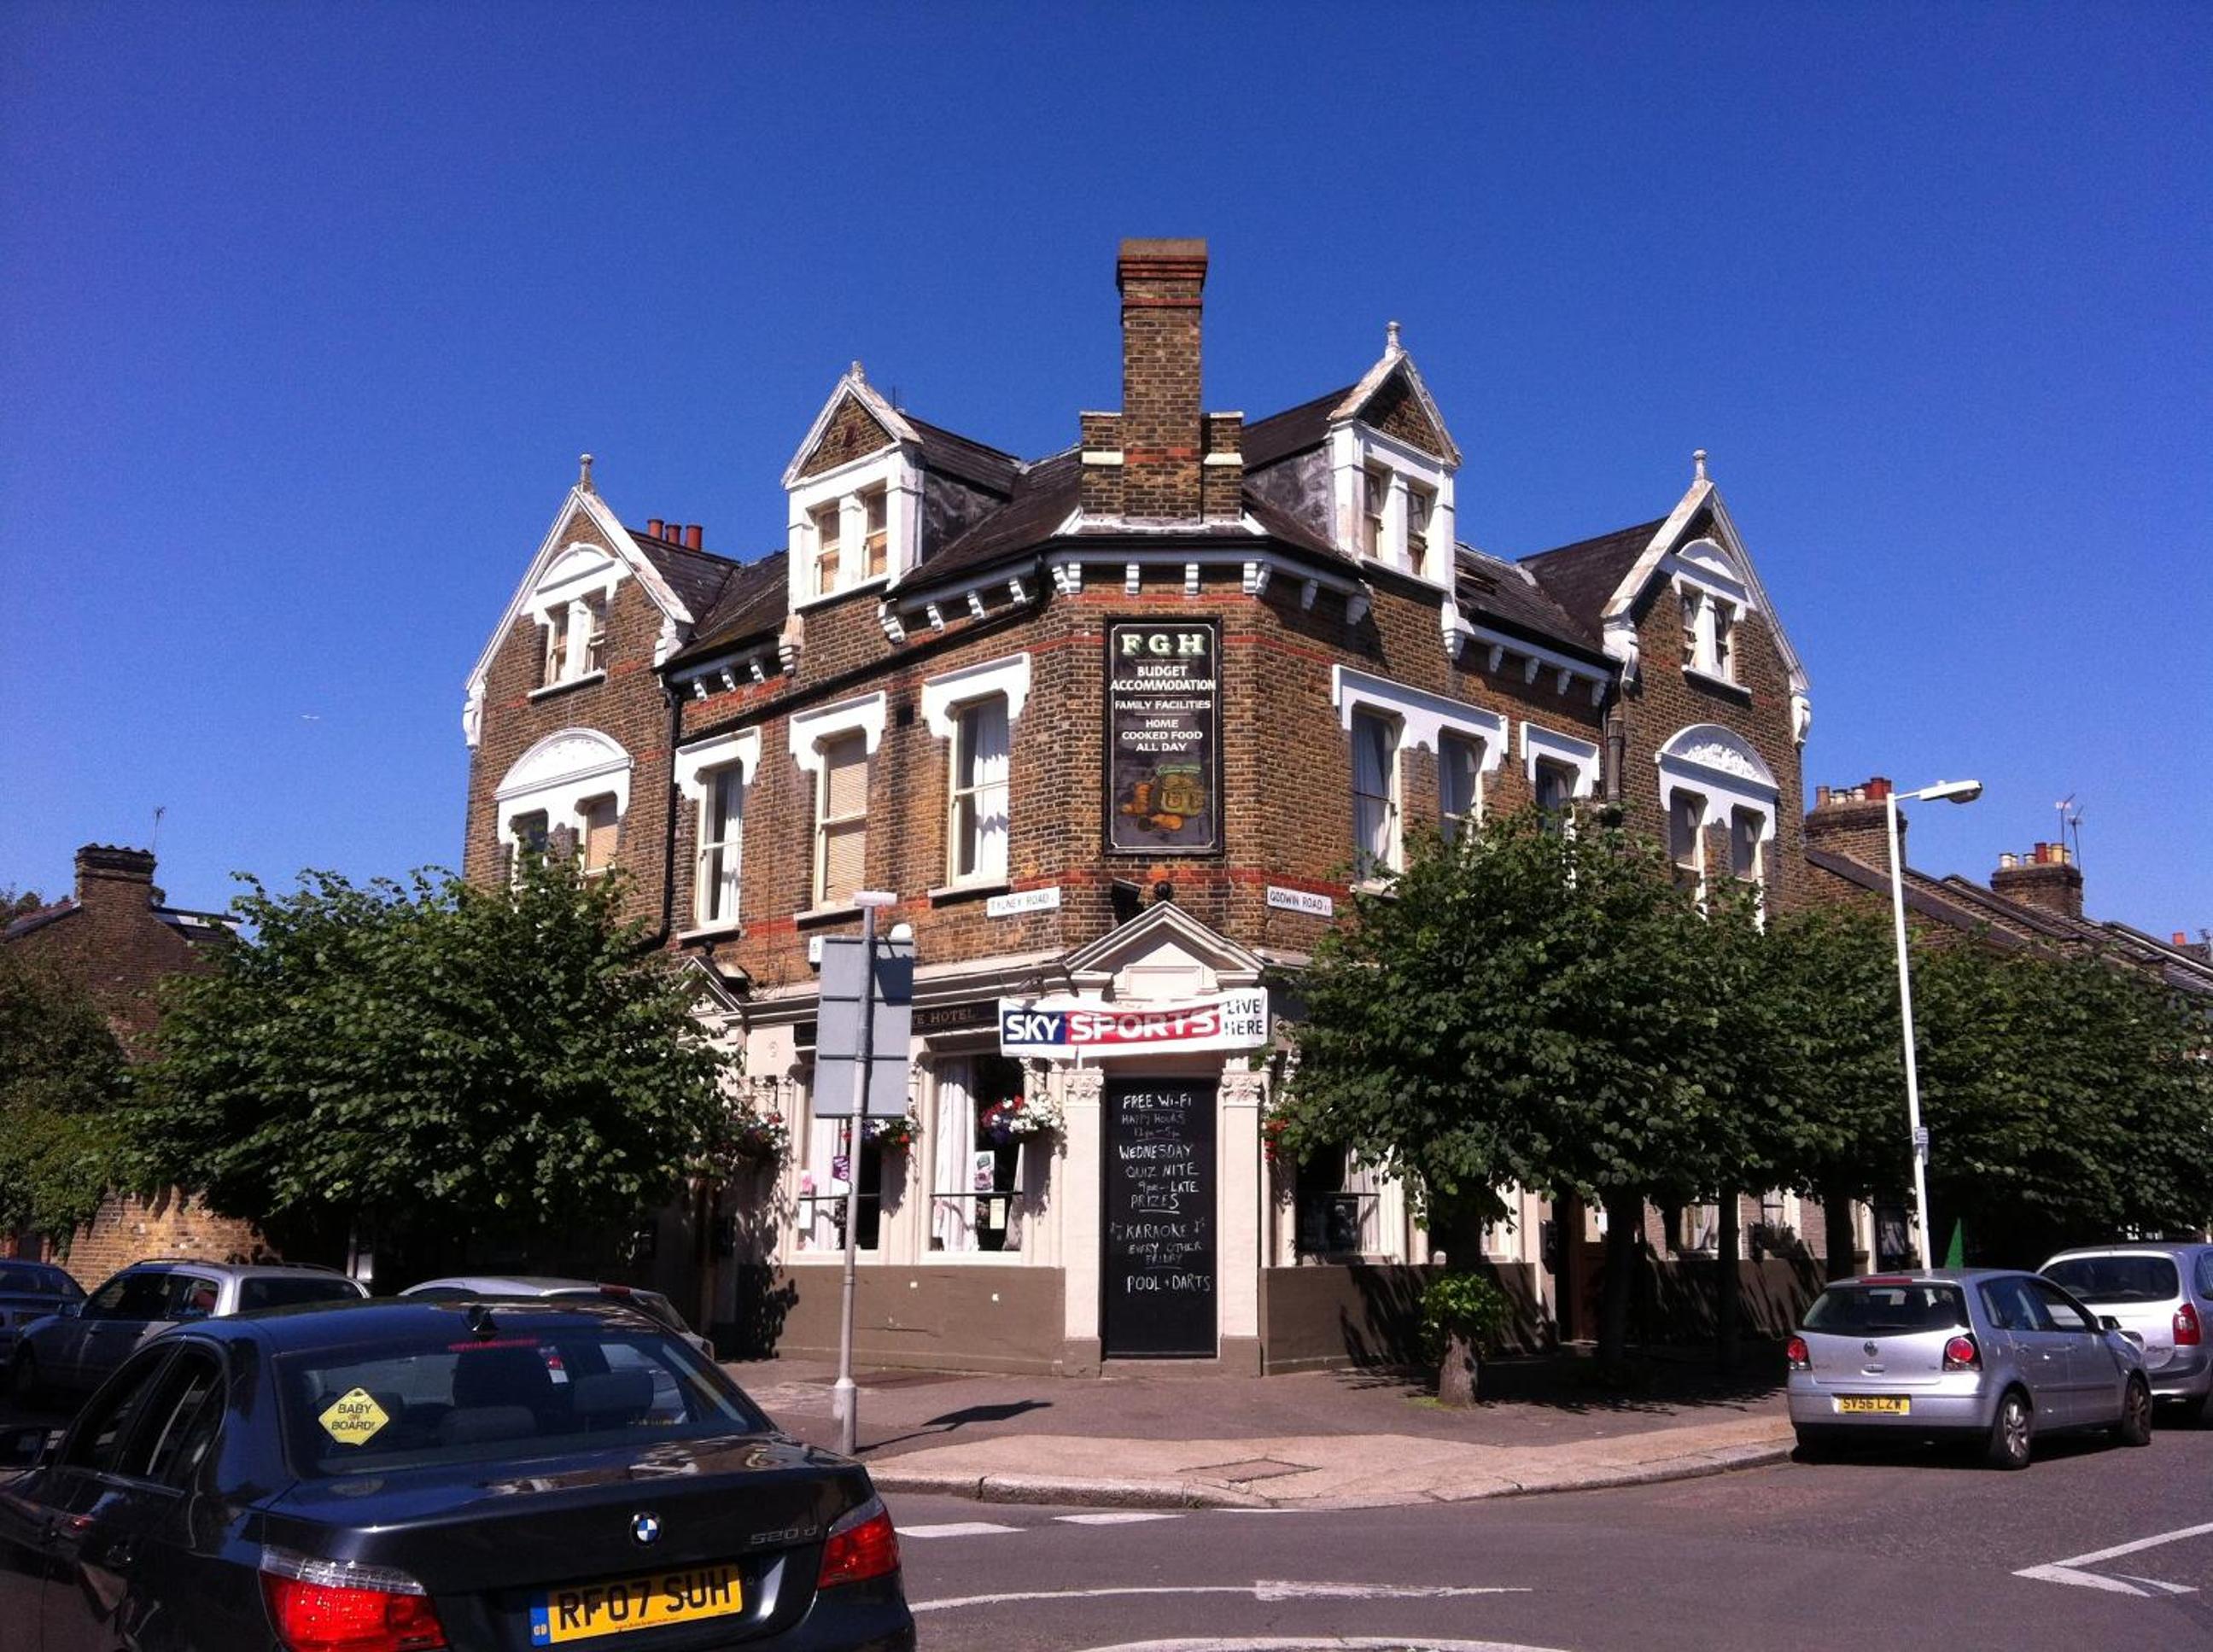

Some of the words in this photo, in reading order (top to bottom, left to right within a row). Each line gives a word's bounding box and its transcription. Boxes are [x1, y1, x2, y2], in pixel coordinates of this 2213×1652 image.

[1137, 666, 1188, 677] BUDGET
[1110, 680, 1216, 691] ACCOMMODATION
[1115, 700, 1152, 709] FAMILY
[1155, 700, 1211, 709] FACILITIES
[1146, 720, 1178, 728] HOME
[1136, 743, 1159, 751] ALL
[1162, 743, 1188, 751] DAY
[1026, 893, 1049, 907] ROAD
[1270, 890, 1299, 906] GODWIN
[1302, 896, 1323, 910] ROAD
[1227, 999, 1261, 1013] LIVE
[931, 1008, 975, 1024] HOTEL
[1006, 1013, 1060, 1041] SKY
[1071, 1011, 1217, 1041] SPORTS
[1225, 1019, 1264, 1036] HERE
[1123, 1095, 1153, 1109] FREE
[1119, 1144, 1194, 1159] WEDNESDAY
[1125, 1165, 1156, 1177] QUIZ
[1163, 1162, 1200, 1177] NITE
[1171, 1181, 1199, 1193] LATE
[1131, 1194, 1180, 1210] PRIZES
[1126, 1223, 1187, 1238] KARAOKE
[1127, 1275, 1161, 1293] POOL
[1172, 1273, 1211, 1291] DARTS
[337, 1404, 372, 1414] BABY
[558, 1582, 651, 1631] RF07
[663, 1569, 730, 1613] SUH
